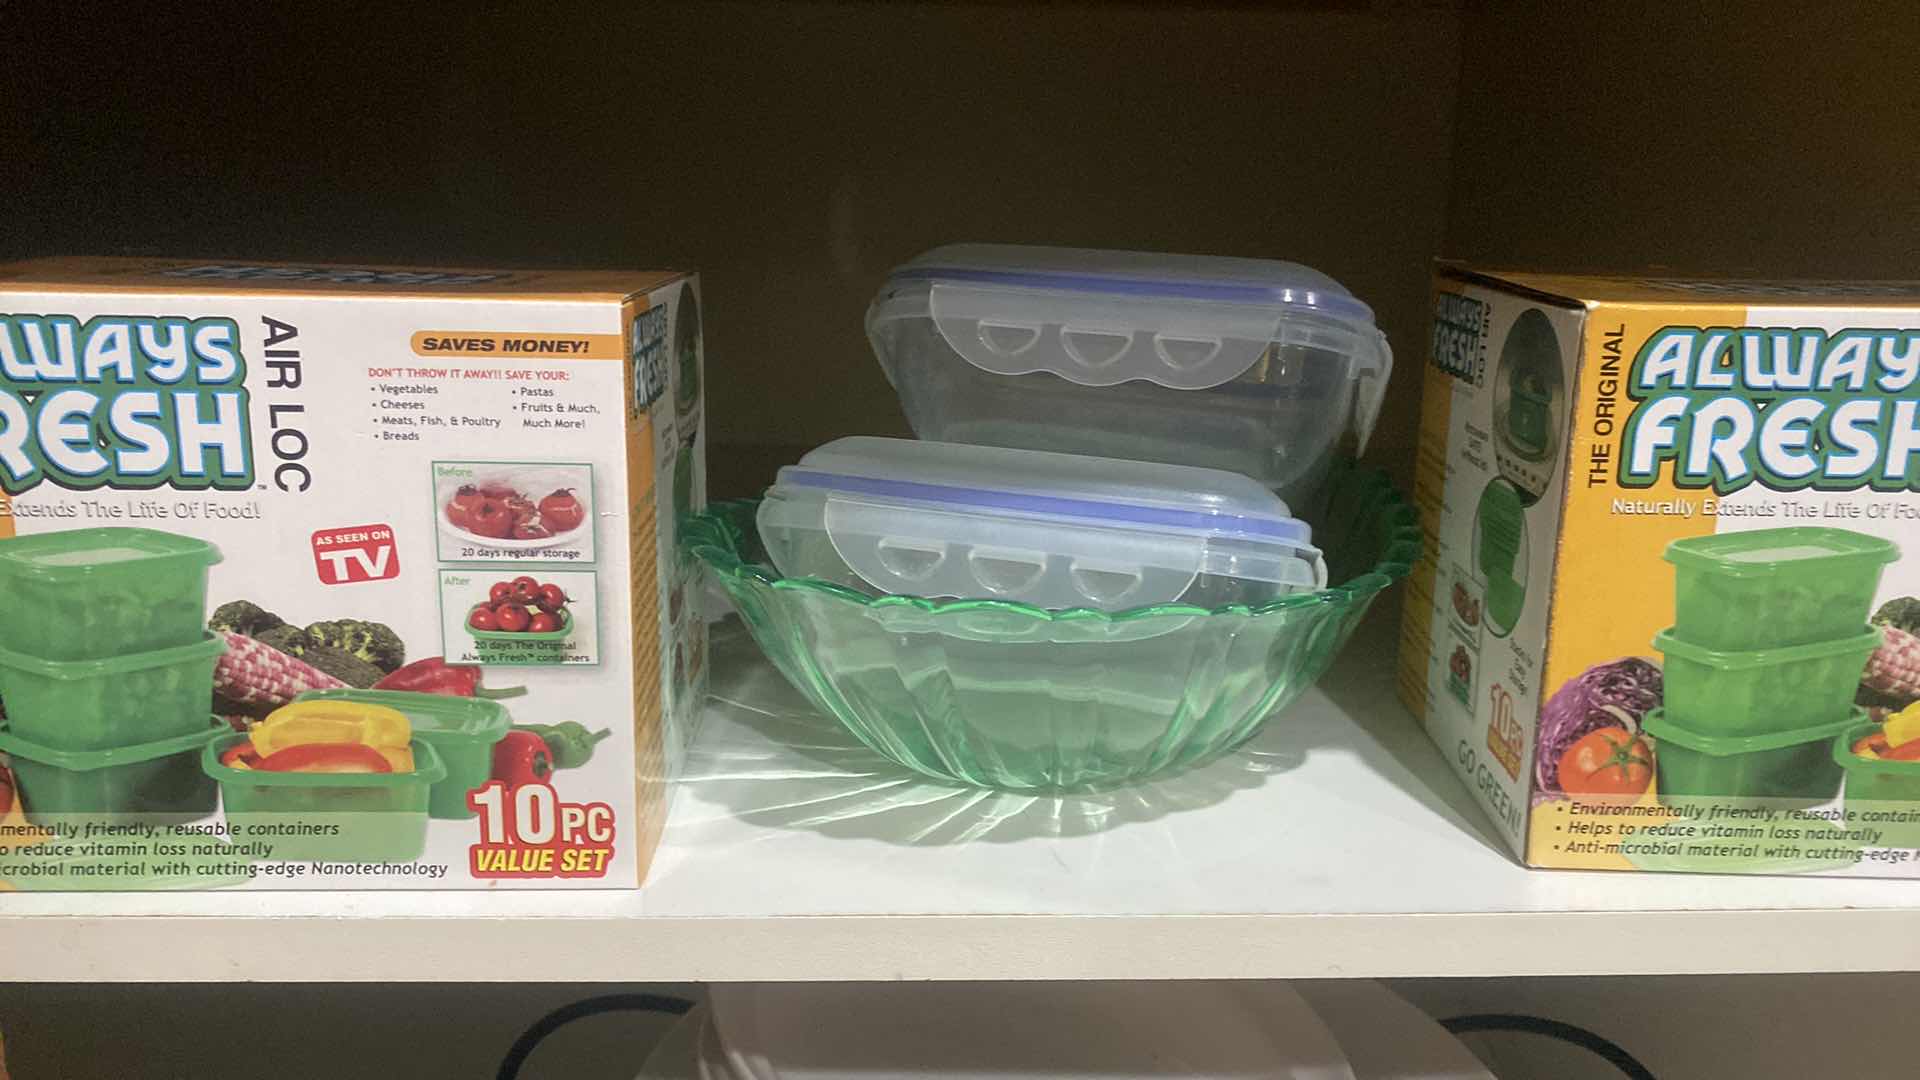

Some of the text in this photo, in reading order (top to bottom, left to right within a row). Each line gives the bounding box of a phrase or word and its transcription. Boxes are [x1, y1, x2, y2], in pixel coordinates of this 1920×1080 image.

[422, 337, 590, 354] SAVES MONEY!
[406, 368, 447, 379] THROW
[450, 369, 461, 379] IT
[505, 370, 533, 380] SAVE
[535, 371, 570, 381] YOUR:
[378, 384, 439, 396] Vegetables
[520, 387, 554, 397] Pastas
[261, 315, 312, 493] AIR LOC
[380, 400, 425, 410] Cheeses
[521, 403, 601, 415] Fruits & Much,
[1588, 323, 1626, 488] THE ORIGINAL
[381, 415, 501, 428] Meats, Fish, & Poultry
[522, 418, 586, 429] Much More!
[382, 431, 420, 441] Breads
[80, 500, 122, 518] The
[127, 500, 168, 519] Life
[174, 502, 200, 519] Of
[203, 501, 262, 520] Food!
[1611, 497, 1697, 519] Naturally
[1701, 498, 1777, 517] Extends
[1781, 501, 1819, 518] The
[1823, 501, 1862, 519] Life
[1866, 502, 1892, 519] Of
[316, 529, 390, 546] AS SEEN ON
[461, 547, 581, 559] 20 days regular storage
[320, 545, 391, 581] TV
[461, 653, 495, 663] Always
[1569, 802, 1703, 821] Environmentally
[1708, 803, 1780, 822] friendly,
[1784, 806, 1857, 822] reusable
[0, 821, 339, 839] mentally friendly, reusable containers
[1567, 821, 1883, 844] Helps to reduce vitamin loss naturally
[15, 842, 74, 856] reduce
[79, 842, 148, 857] vitamin
[153, 842, 187, 856] loss
[192, 842, 274, 859] naturally
[1565, 839, 1683, 857] Anti-microbial
[1688, 843, 1760, 858] material
[1763, 843, 1801, 859] with
[1805, 845, 1910, 864] cutting-edge
[476, 848, 609, 872] VALUE SET
[69, 862, 146, 877] material
[151, 862, 189, 876] with
[195, 862, 306, 878] cutting-edge
[311, 861, 449, 878] Nanotechnology
